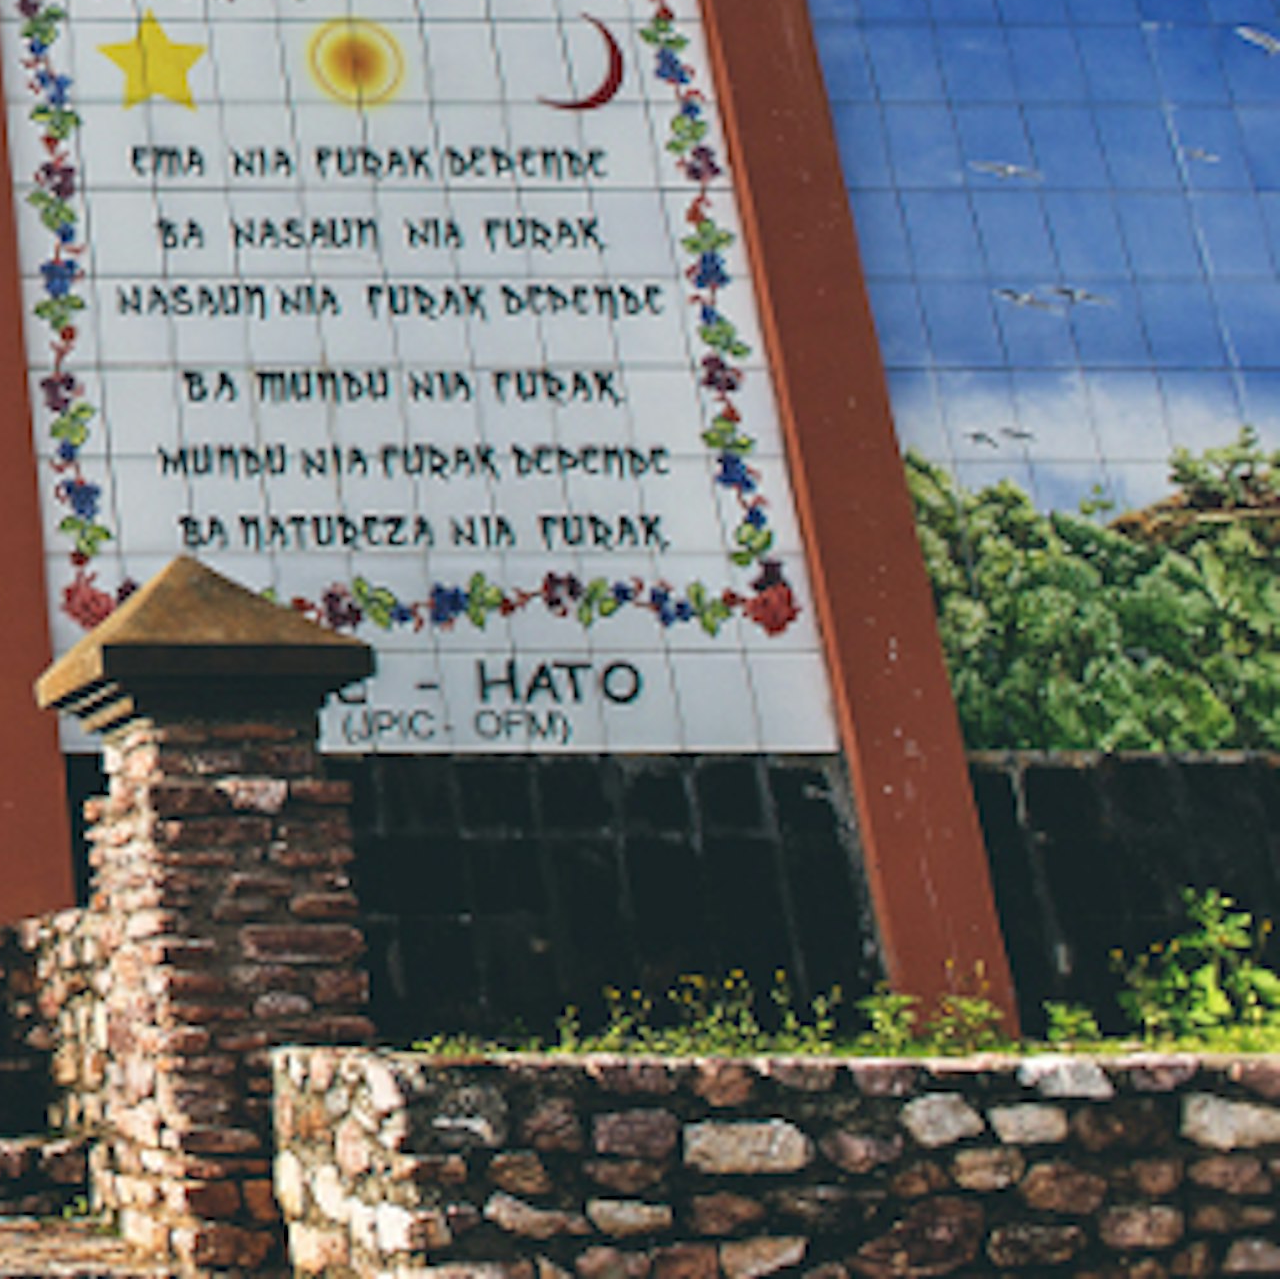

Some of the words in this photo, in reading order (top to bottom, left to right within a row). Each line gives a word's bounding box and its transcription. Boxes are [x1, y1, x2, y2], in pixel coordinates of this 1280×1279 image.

[232, 145, 294, 178] NIA
[156, 217, 204, 250] BA
[405, 217, 464, 250] NIA
[278, 285, 340, 318] NIA
[183, 370, 237, 402] BA
[409, 370, 472, 403] NIA
[301, 446, 368, 478] NIA
[181, 517, 230, 551] BA
[452, 517, 516, 551] NIA
[476, 659, 642, 705] HATO
